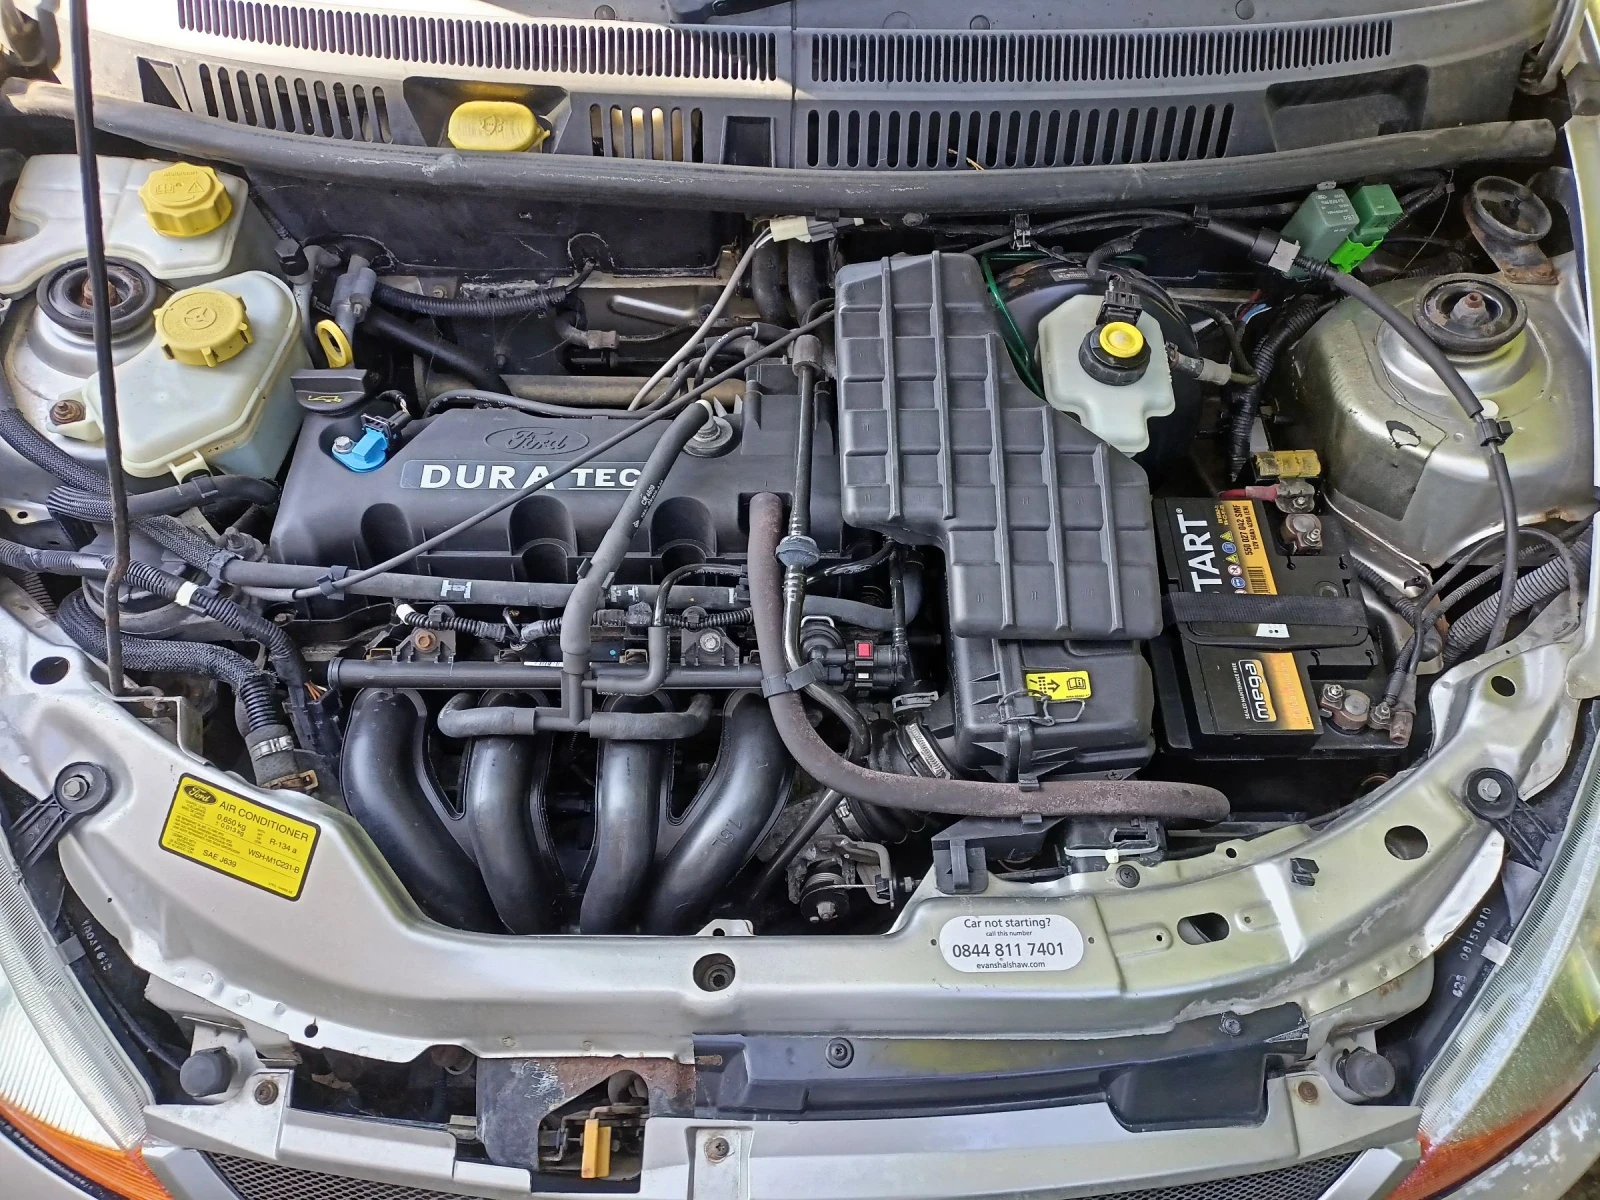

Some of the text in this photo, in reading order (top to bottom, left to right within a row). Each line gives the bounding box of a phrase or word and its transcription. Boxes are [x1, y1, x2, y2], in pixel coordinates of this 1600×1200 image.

[505, 429, 569, 451] Ford
[419, 464, 642, 490] DURA TEC
[1233, 504, 1243, 518] SMF
[1245, 663, 1270, 719] mega
[188, 787, 210, 803] Ford
[219, 801, 237, 814] AIR
[237, 807, 309, 842] CONDITIONER
[237, 819, 247, 831] kg
[236, 827, 245, 837] kg
[269, 838, 291, 852] R-134
[202, 849, 237, 868] SAE J639
[963, 917, 1051, 929] Car not starting?
[952, 942, 1064, 958] 0844 811 7401
[976, 961, 1046, 969] evanshalshaw.com
